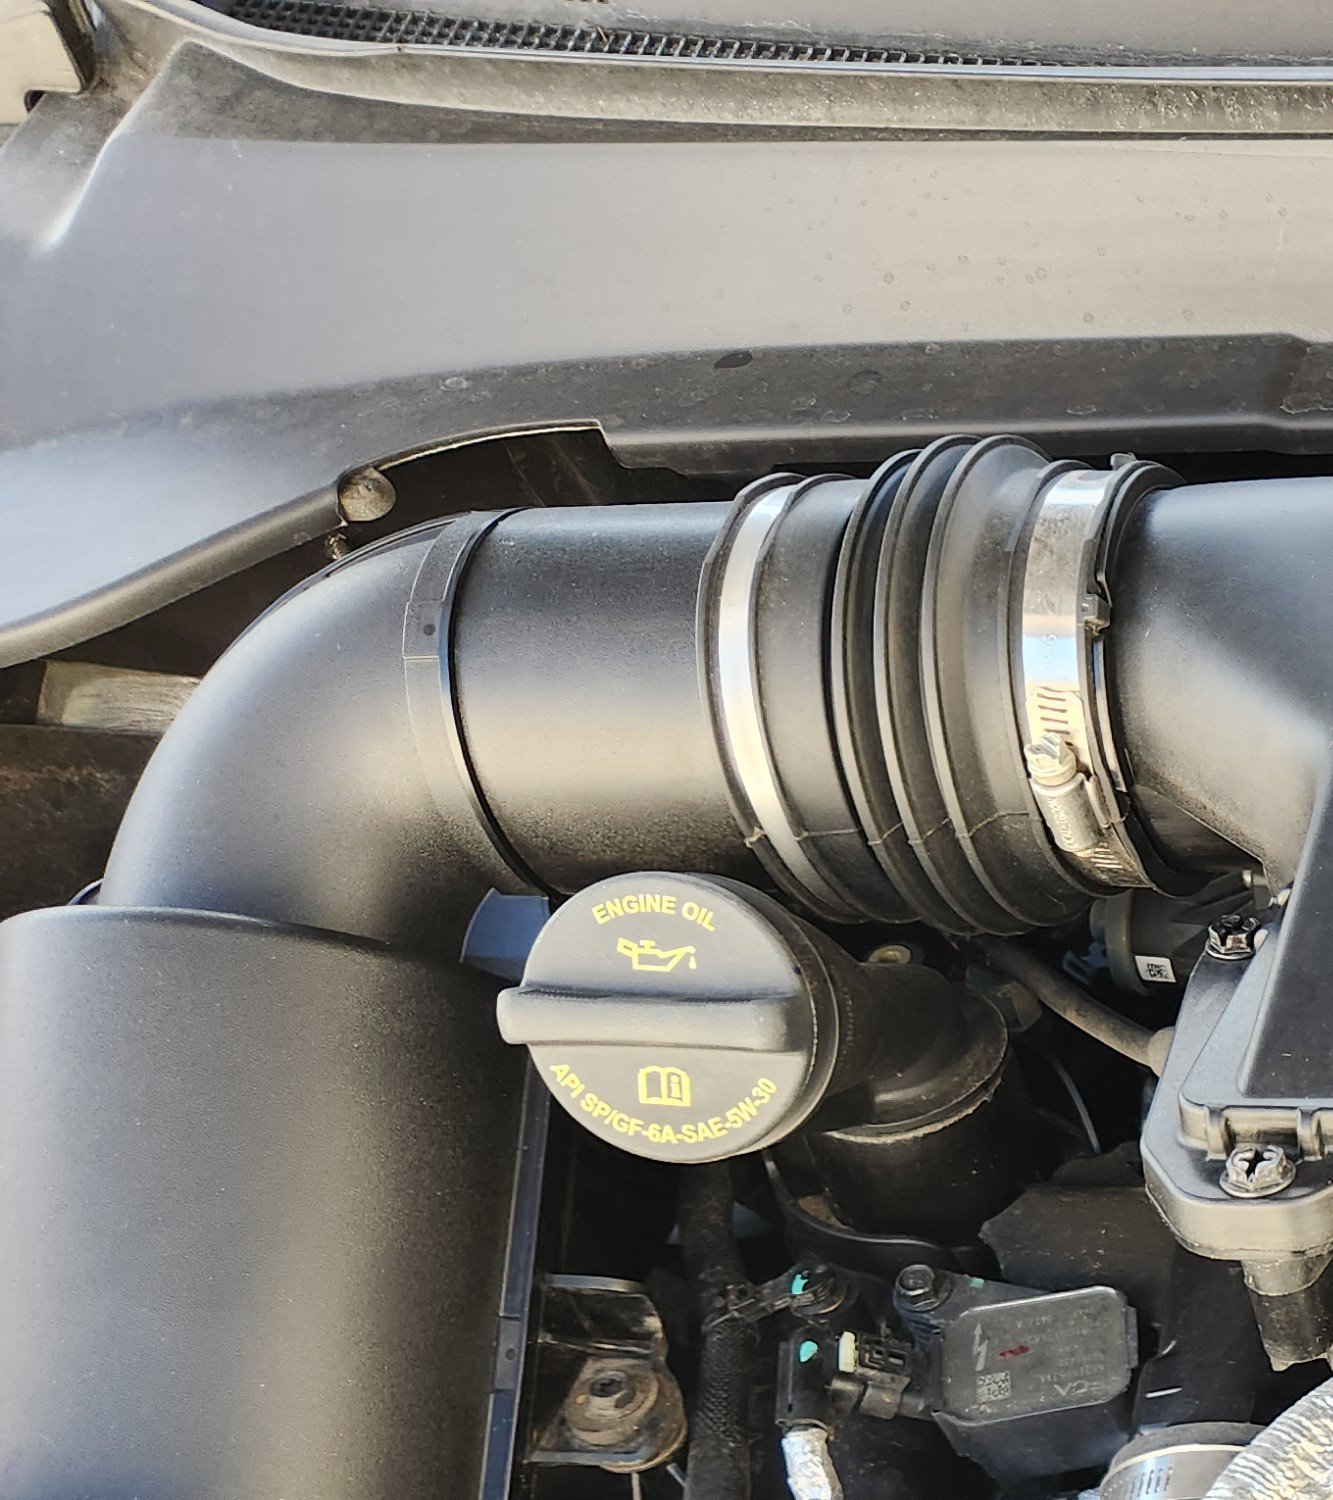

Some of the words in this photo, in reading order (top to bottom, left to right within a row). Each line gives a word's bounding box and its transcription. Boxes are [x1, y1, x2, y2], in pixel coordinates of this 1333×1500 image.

[592, 893, 677, 925] ENGINE
[683, 901, 716, 931] OIL
[549, 1062, 585, 1098] API
